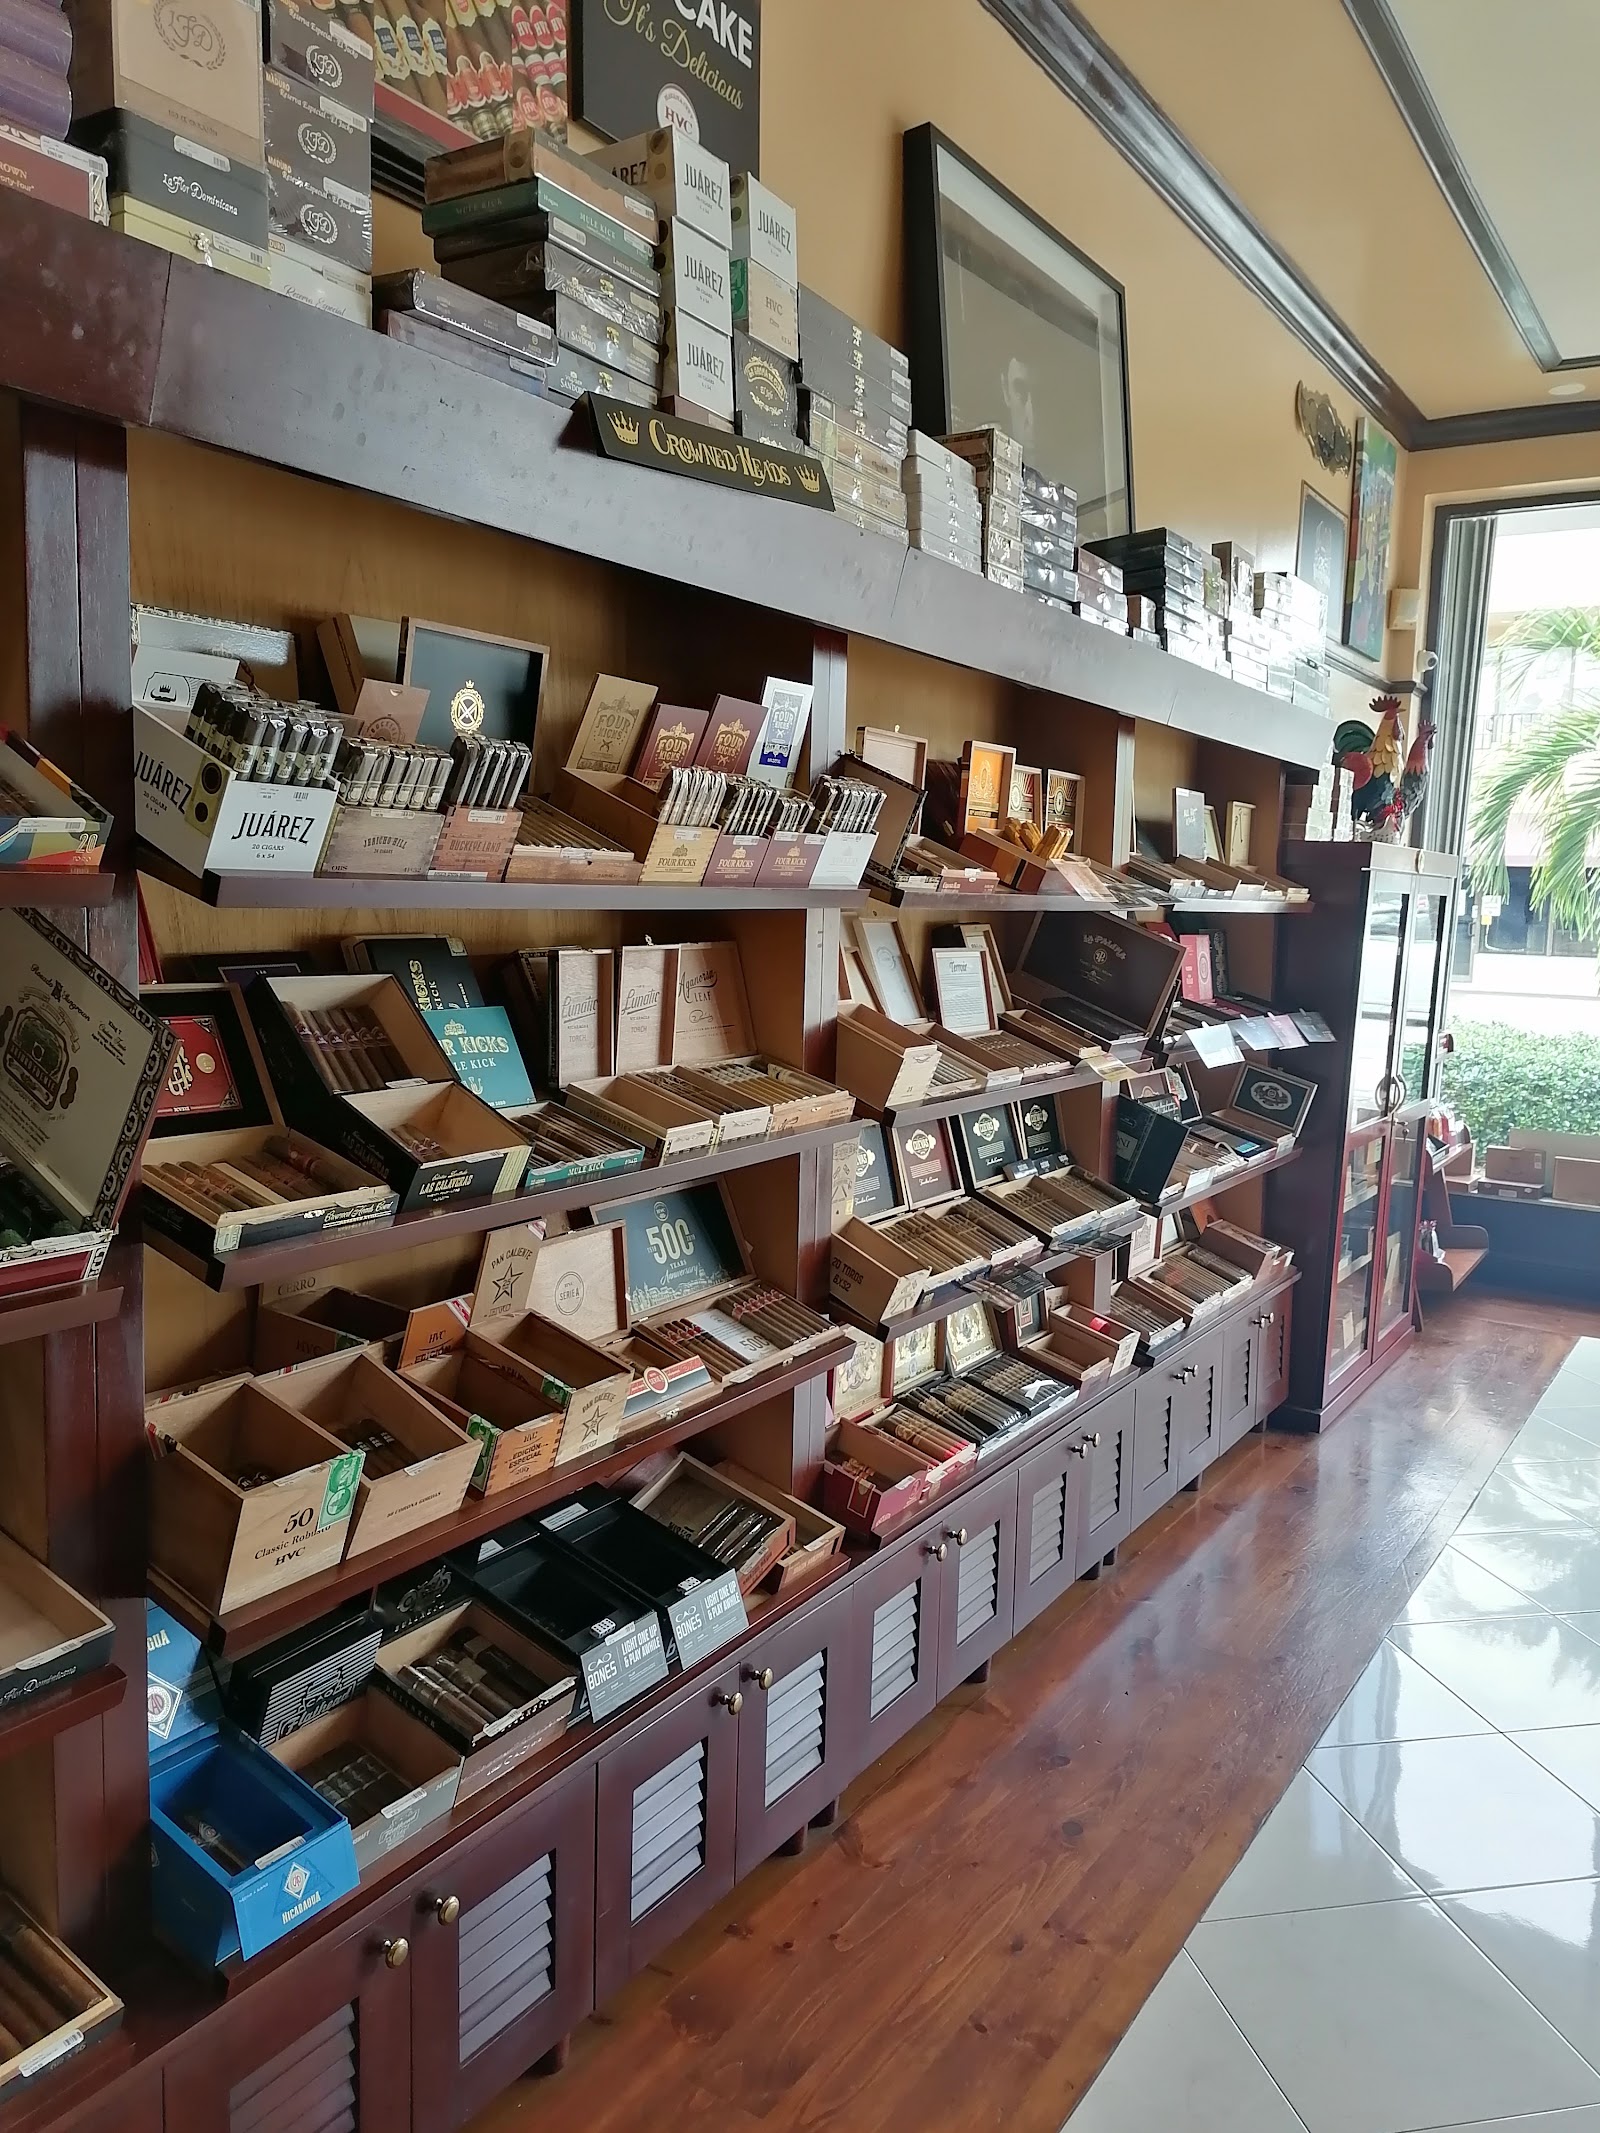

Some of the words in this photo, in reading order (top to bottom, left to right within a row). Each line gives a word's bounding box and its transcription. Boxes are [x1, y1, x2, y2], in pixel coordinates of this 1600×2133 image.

[660, 18, 744, 110] Delicious
[265, 71, 290, 92] MADURO
[665, 105, 694, 135] HVC
[268, 155, 292, 174] MADURO
[684, 163, 724, 211] JUÁREZ
[190, 181, 238, 216] Dominicana
[580, 212, 598, 229] MULE
[757, 210, 792, 255] JUÁREZ
[685, 255, 724, 300] JUÁREZ
[284, 285, 314, 305] Reserva
[315, 295, 347, 317] Especial
[765, 296, 783, 316] HVC
[686, 343, 726, 385] JUÁREZ
[648, 417, 734, 475] CROWNED
[736, 445, 792, 487] HEADS
[596, 714, 631, 733] FOUR
[597, 727, 622, 740] KICKS
[657, 739, 688, 756] FOUR
[716, 735, 744, 752] FOUR
[717, 744, 736, 757] KICKS
[660, 750, 680, 761] KICKS
[135, 750, 192, 815] JUÁREZ
[231, 810, 315, 845] JUÁREZ
[75, 833, 99, 854] 20
[363, 836, 392, 848] JERICHO
[393, 837, 408, 849] HILL
[658, 858, 676, 867] FOUR
[676, 858, 697, 867] KICKS
[718, 859, 738, 867] FOUR
[775, 857, 791, 865] FOUR
[791, 858, 807, 866] KICKS
[409, 959, 433, 1012] KICKS
[429, 981, 444, 1010] KICK
[562, 995, 599, 1019] Lunatic
[621, 988, 660, 1016] Lunatic
[694, 991, 712, 1002] LEAF
[458, 1036, 510, 1054] KICKS
[569, 1035, 587, 1043] TORCH
[470, 1057, 497, 1069] KICK
[588, 1109, 633, 1133] VISIONARIES
[568, 1165, 587, 1176] MULE
[588, 1162, 605, 1173] KICK
[419, 1182, 435, 1196] LAS
[435, 1174, 474, 1194] CALAVERAS
[645, 1218, 695, 1265] 500
[491, 1255, 504, 1269] PAN
[506, 1247, 533, 1260] CALIENTE
[669, 1259, 687, 1269] YEARS
[660, 1265, 700, 1286] Anniversary
[831, 1257, 841, 1269] 20
[841, 1262, 864, 1285] TOROS
[278, 1277, 316, 1295] CERRO
[560, 1290, 575, 1301] SERIE
[429, 1329, 447, 1344] HVC
[582, 1401, 594, 1414] PAN
[508, 1450, 542, 1468] ESPECIAL
[513, 1442, 542, 1460] EDICIÓN
[283, 1507, 314, 1535] 50
[254, 1541, 290, 1560] Classic
[275, 1548, 306, 1567] HVC
[704, 1589, 720, 1610] LIGHT
[719, 1585, 731, 1601] ONE
[730, 1580, 737, 1594] UP
[675, 1605, 697, 1624] CAO
[712, 1603, 724, 1620] PLAY
[723, 1592, 741, 1613] AWHILE
[675, 1613, 702, 1640] BONES
[621, 1635, 638, 1656] LIGHT
[637, 1628, 650, 1646] ONE
[649, 1623, 658, 1639] UP
[588, 1652, 612, 1672] CAO
[629, 1648, 642, 1666] PLAY
[642, 1637, 661, 1658] AWHILE
[23, 1666, 77, 1693] Dominicana
[588, 1661, 618, 1690] BONES
[307, 1689, 332, 1707] CAO
[281, 1891, 322, 1925] NICARAGUA
